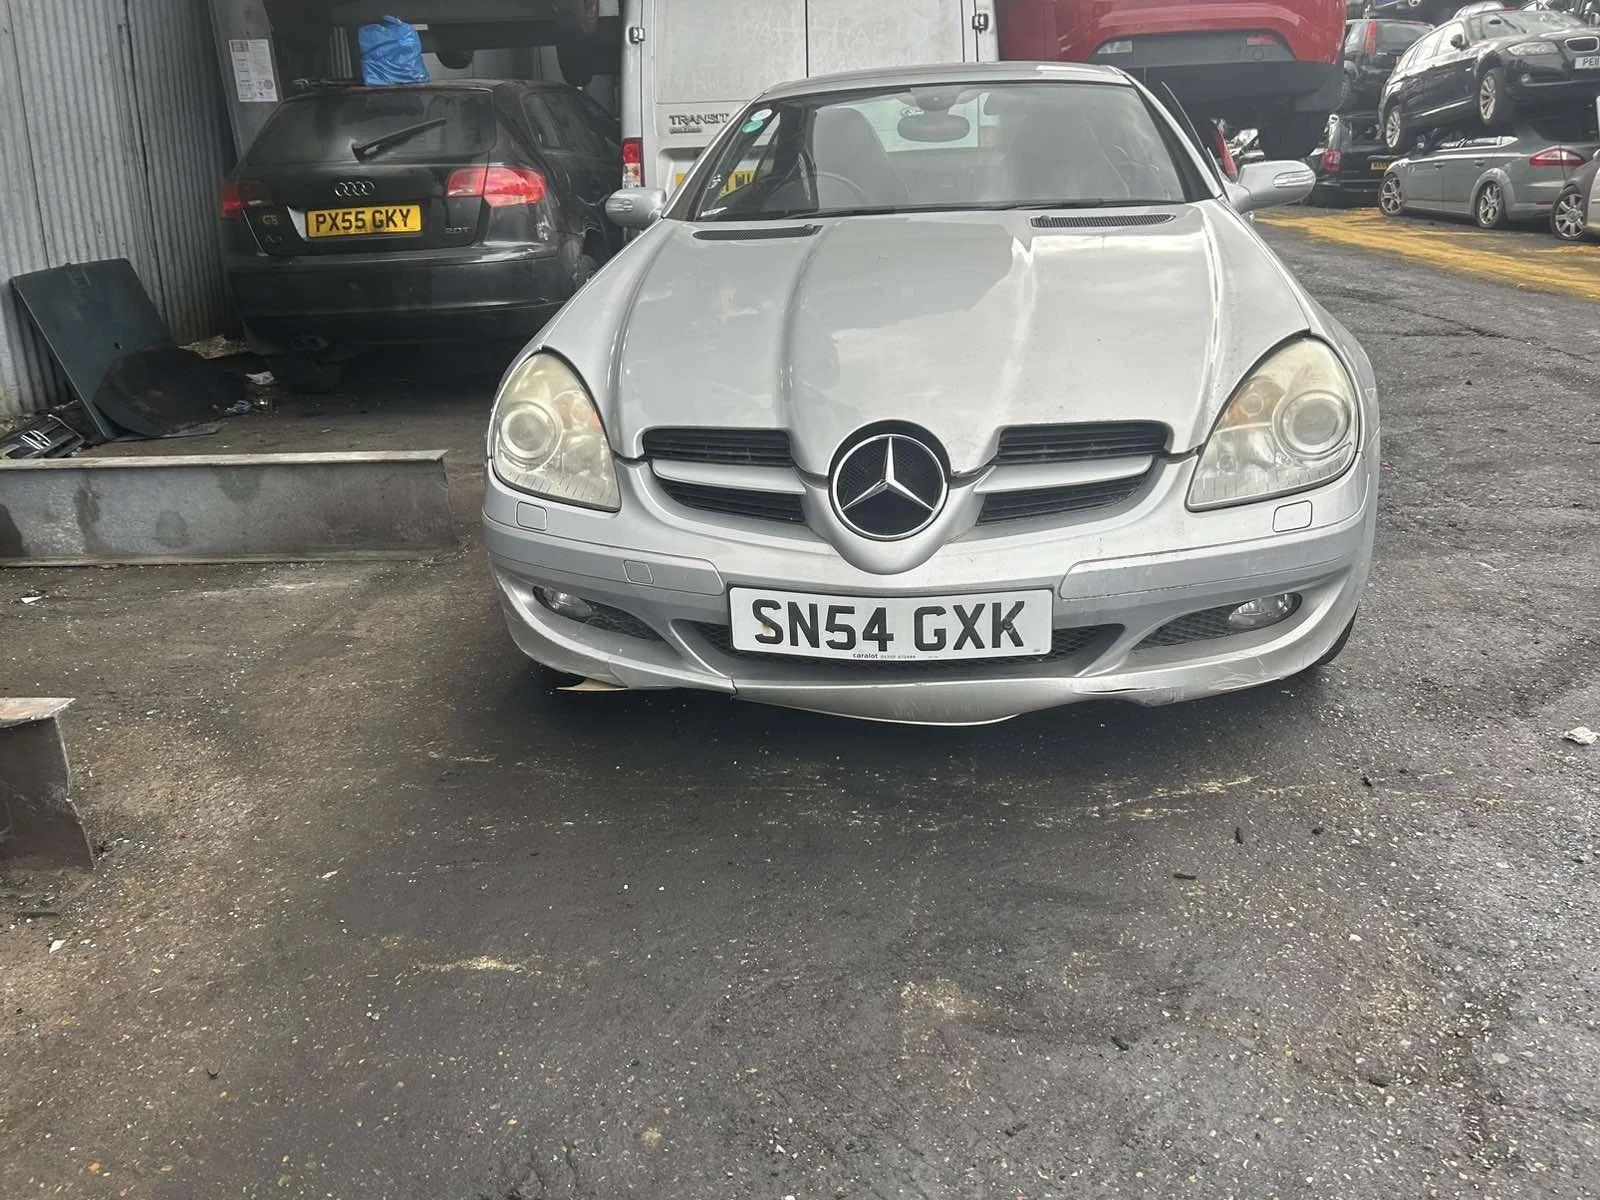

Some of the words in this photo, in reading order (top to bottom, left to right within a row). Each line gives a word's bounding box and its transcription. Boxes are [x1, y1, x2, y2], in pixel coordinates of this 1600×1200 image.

[669, 112, 729, 126] TRANSIT
[316, 211, 366, 232] PX55
[372, 208, 411, 228] GKY
[752, 598, 895, 652] SN54
[913, 600, 1025, 652] GXK
